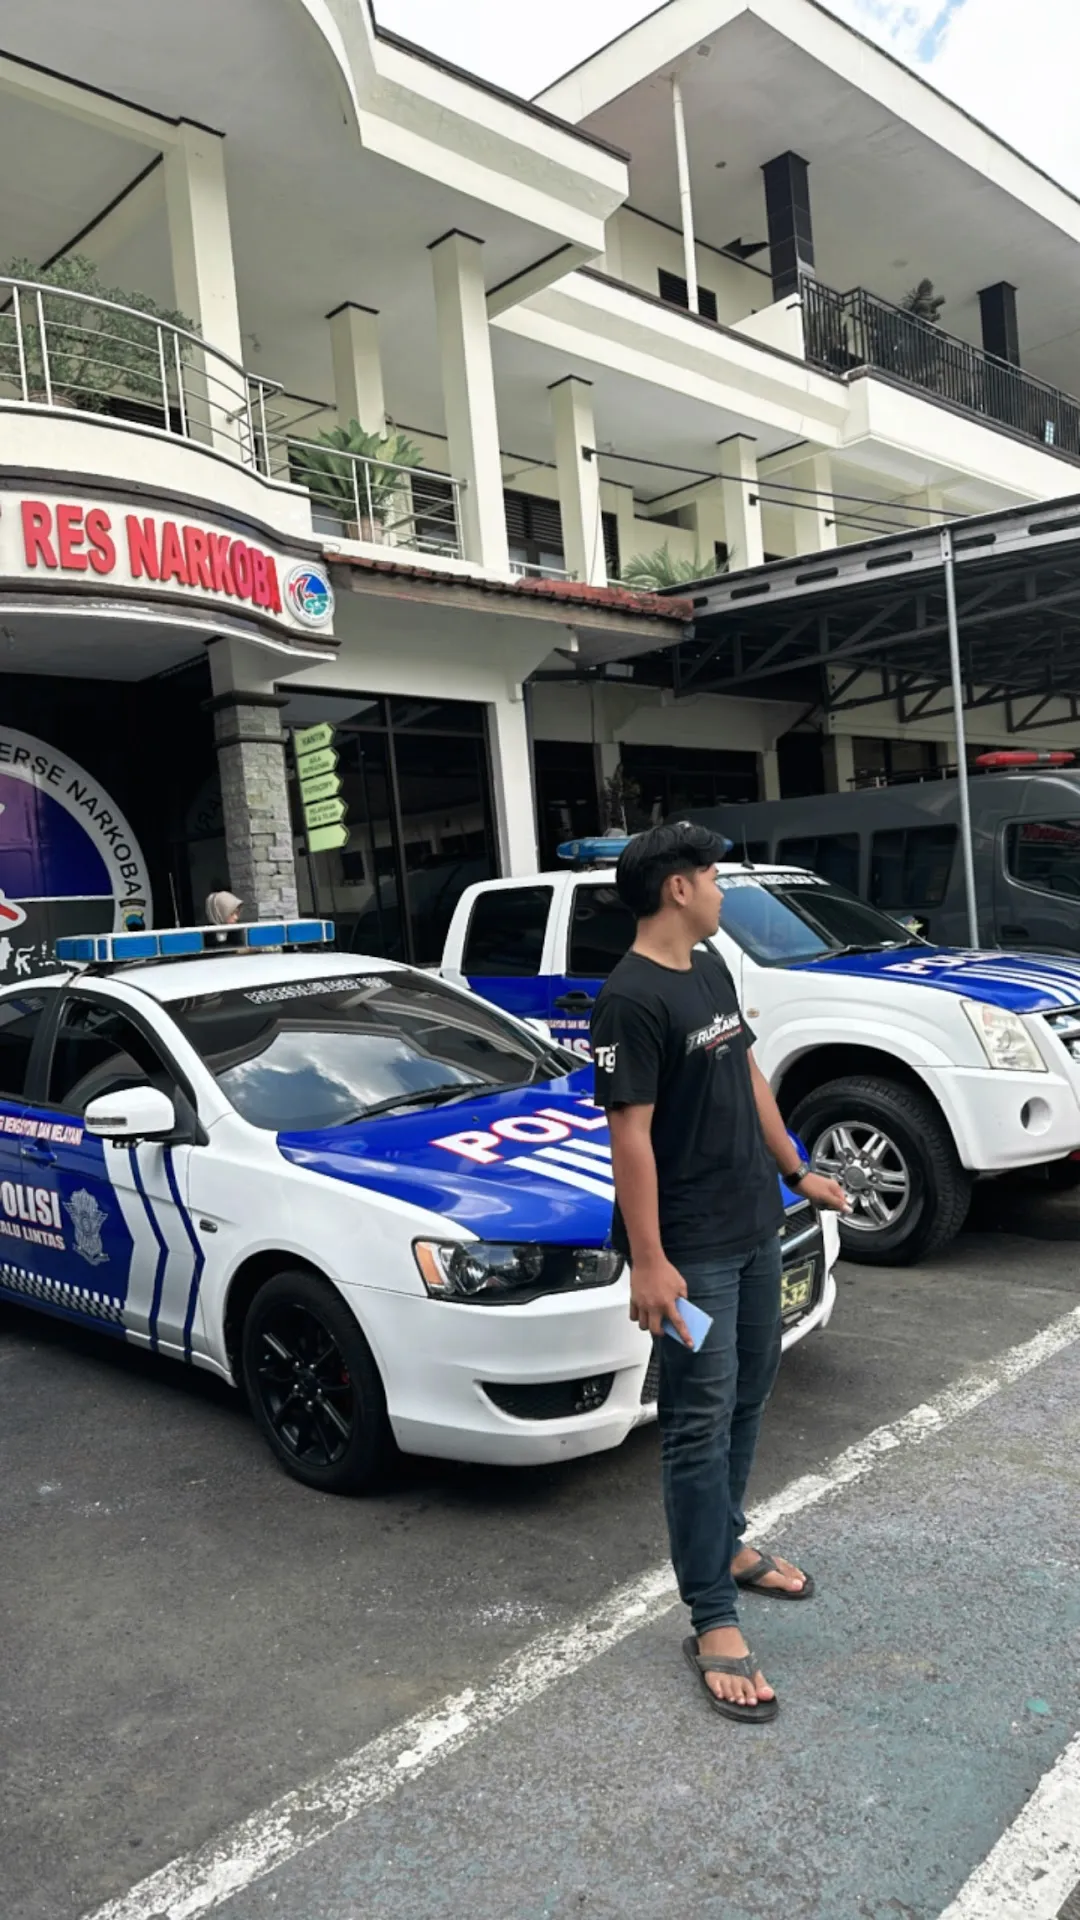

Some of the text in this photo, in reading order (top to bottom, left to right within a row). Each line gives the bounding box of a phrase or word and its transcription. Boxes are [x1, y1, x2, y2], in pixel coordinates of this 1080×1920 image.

[21, 500, 117, 576] RES
[125, 513, 283, 614] NARKOBA
[66, 780, 143, 897] NARKOBA
[0, 1181, 62, 1229] OLISI
[22, 1225, 66, 1251] LINTAS
